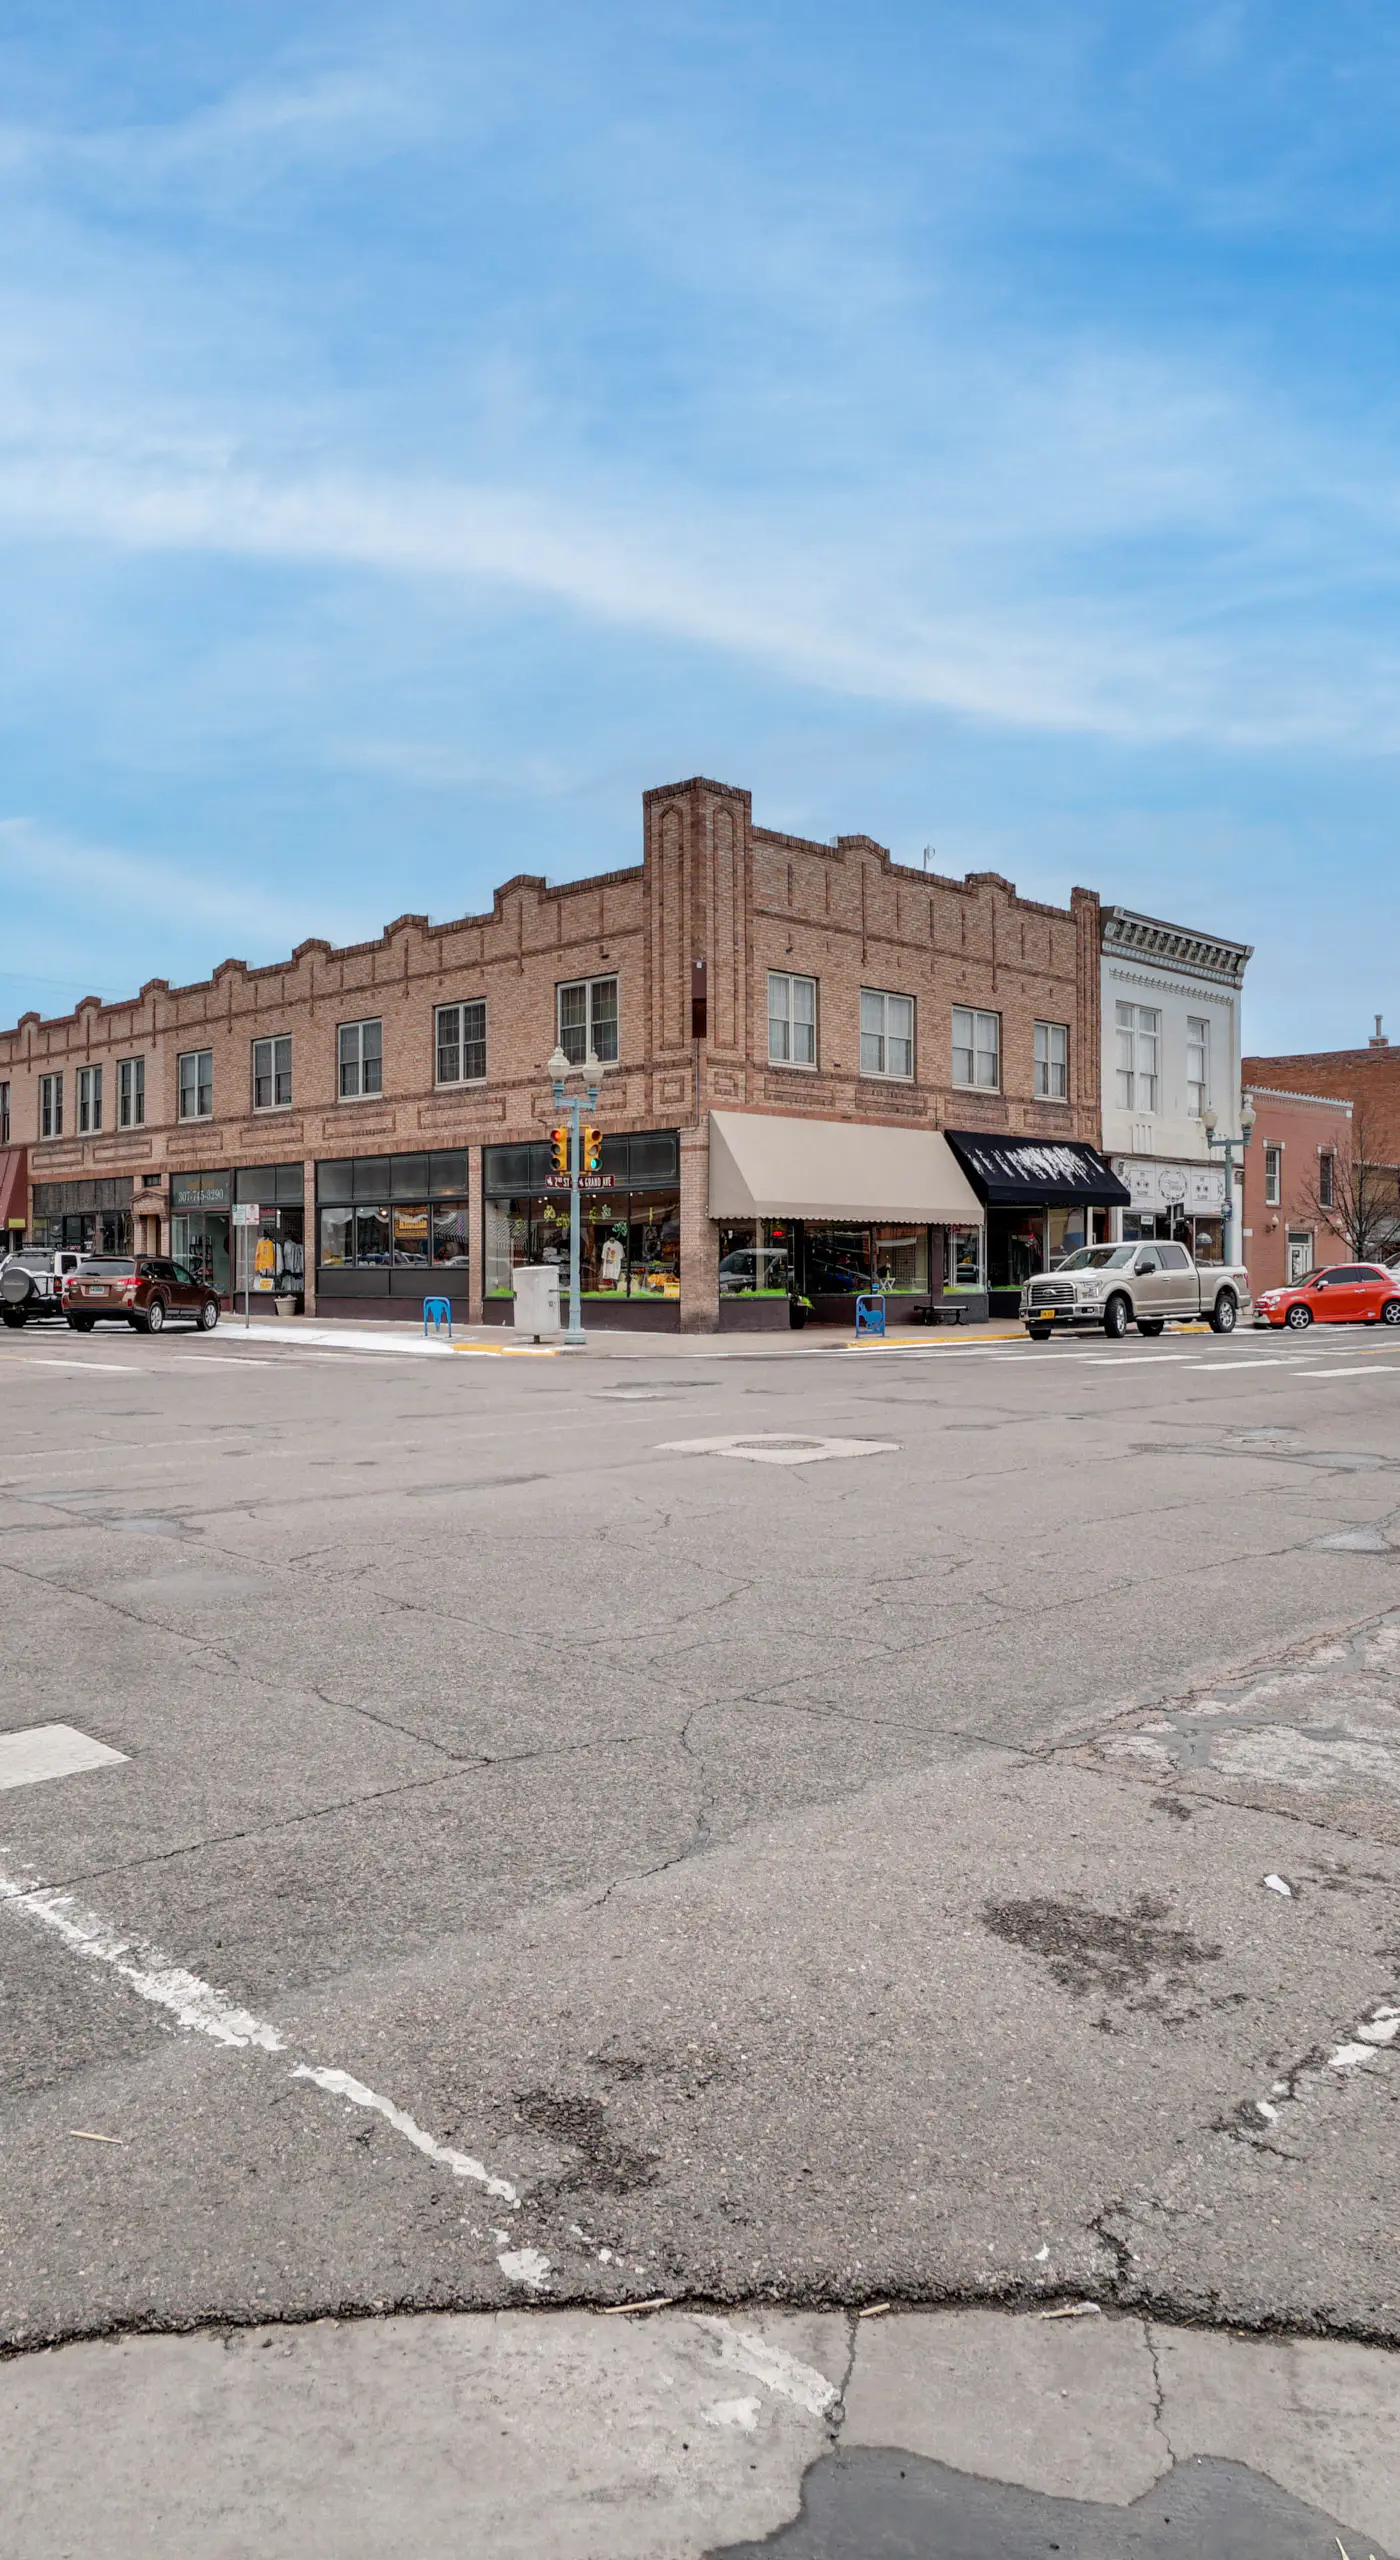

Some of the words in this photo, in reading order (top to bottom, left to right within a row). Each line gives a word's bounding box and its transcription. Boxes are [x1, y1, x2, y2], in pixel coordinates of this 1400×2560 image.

[563, 1177, 570, 1187] ST
[584, 1177, 602, 1187] GRAND
[602, 1176, 612, 1187] AVE
